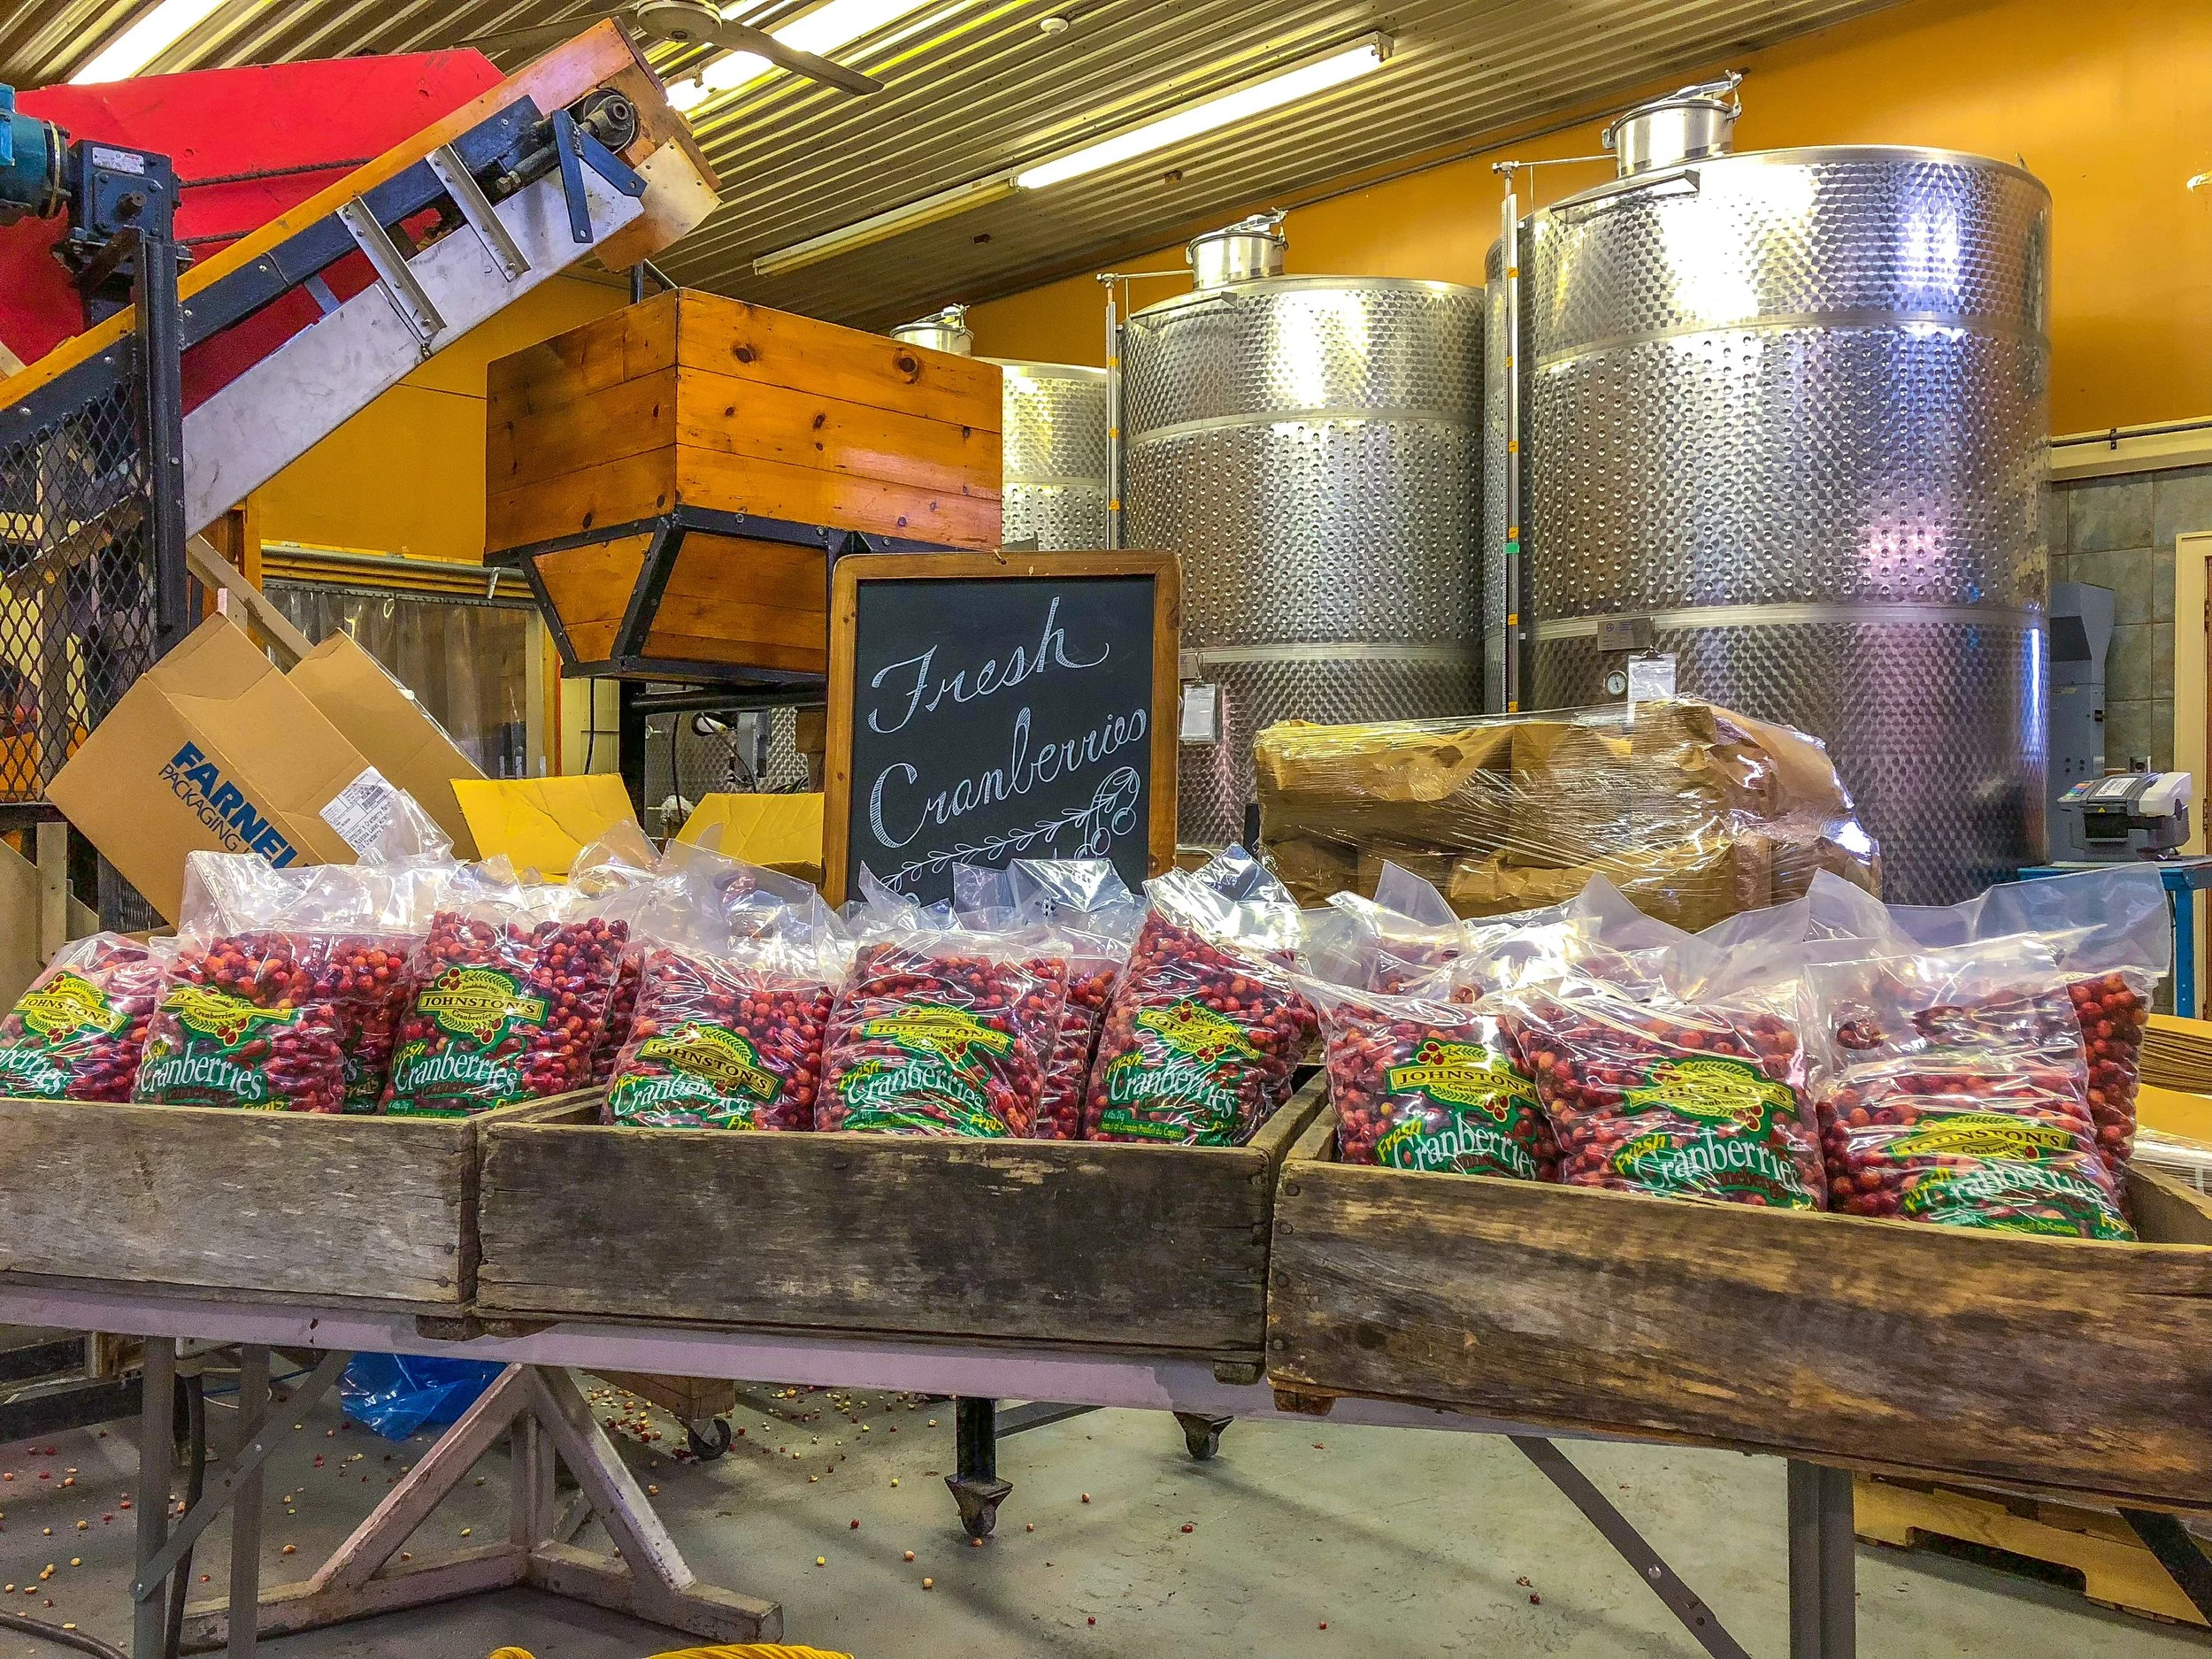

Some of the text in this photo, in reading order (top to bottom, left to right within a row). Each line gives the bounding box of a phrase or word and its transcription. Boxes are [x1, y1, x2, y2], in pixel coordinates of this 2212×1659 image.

[868, 596, 1110, 733] Fresh
[171, 740, 309, 869] FARNEL
[870, 707, 1146, 848] Cranberries
[157, 763, 242, 852] PACKAGING
[194, 1007, 237, 1019] Cranberries
[424, 996, 535, 1014] JOHNSTON'S
[451, 1010, 492, 1021] Cranberries
[140, 1041, 263, 1101] Cranberries
[394, 1039, 518, 1096] Cranberries
[652, 1043, 768, 1090] JOHNSTON'S
[847, 1061, 985, 1112] Cranberries
[1110, 1060, 1235, 1118] Cranberries
[1399, 1070, 1533, 1098] JOHNSTON'S
[1377, 1118, 1422, 1162] Fresh
[1394, 1113, 1537, 1180] Cranberries
[1634, 1125, 1802, 1196] Cranberries
